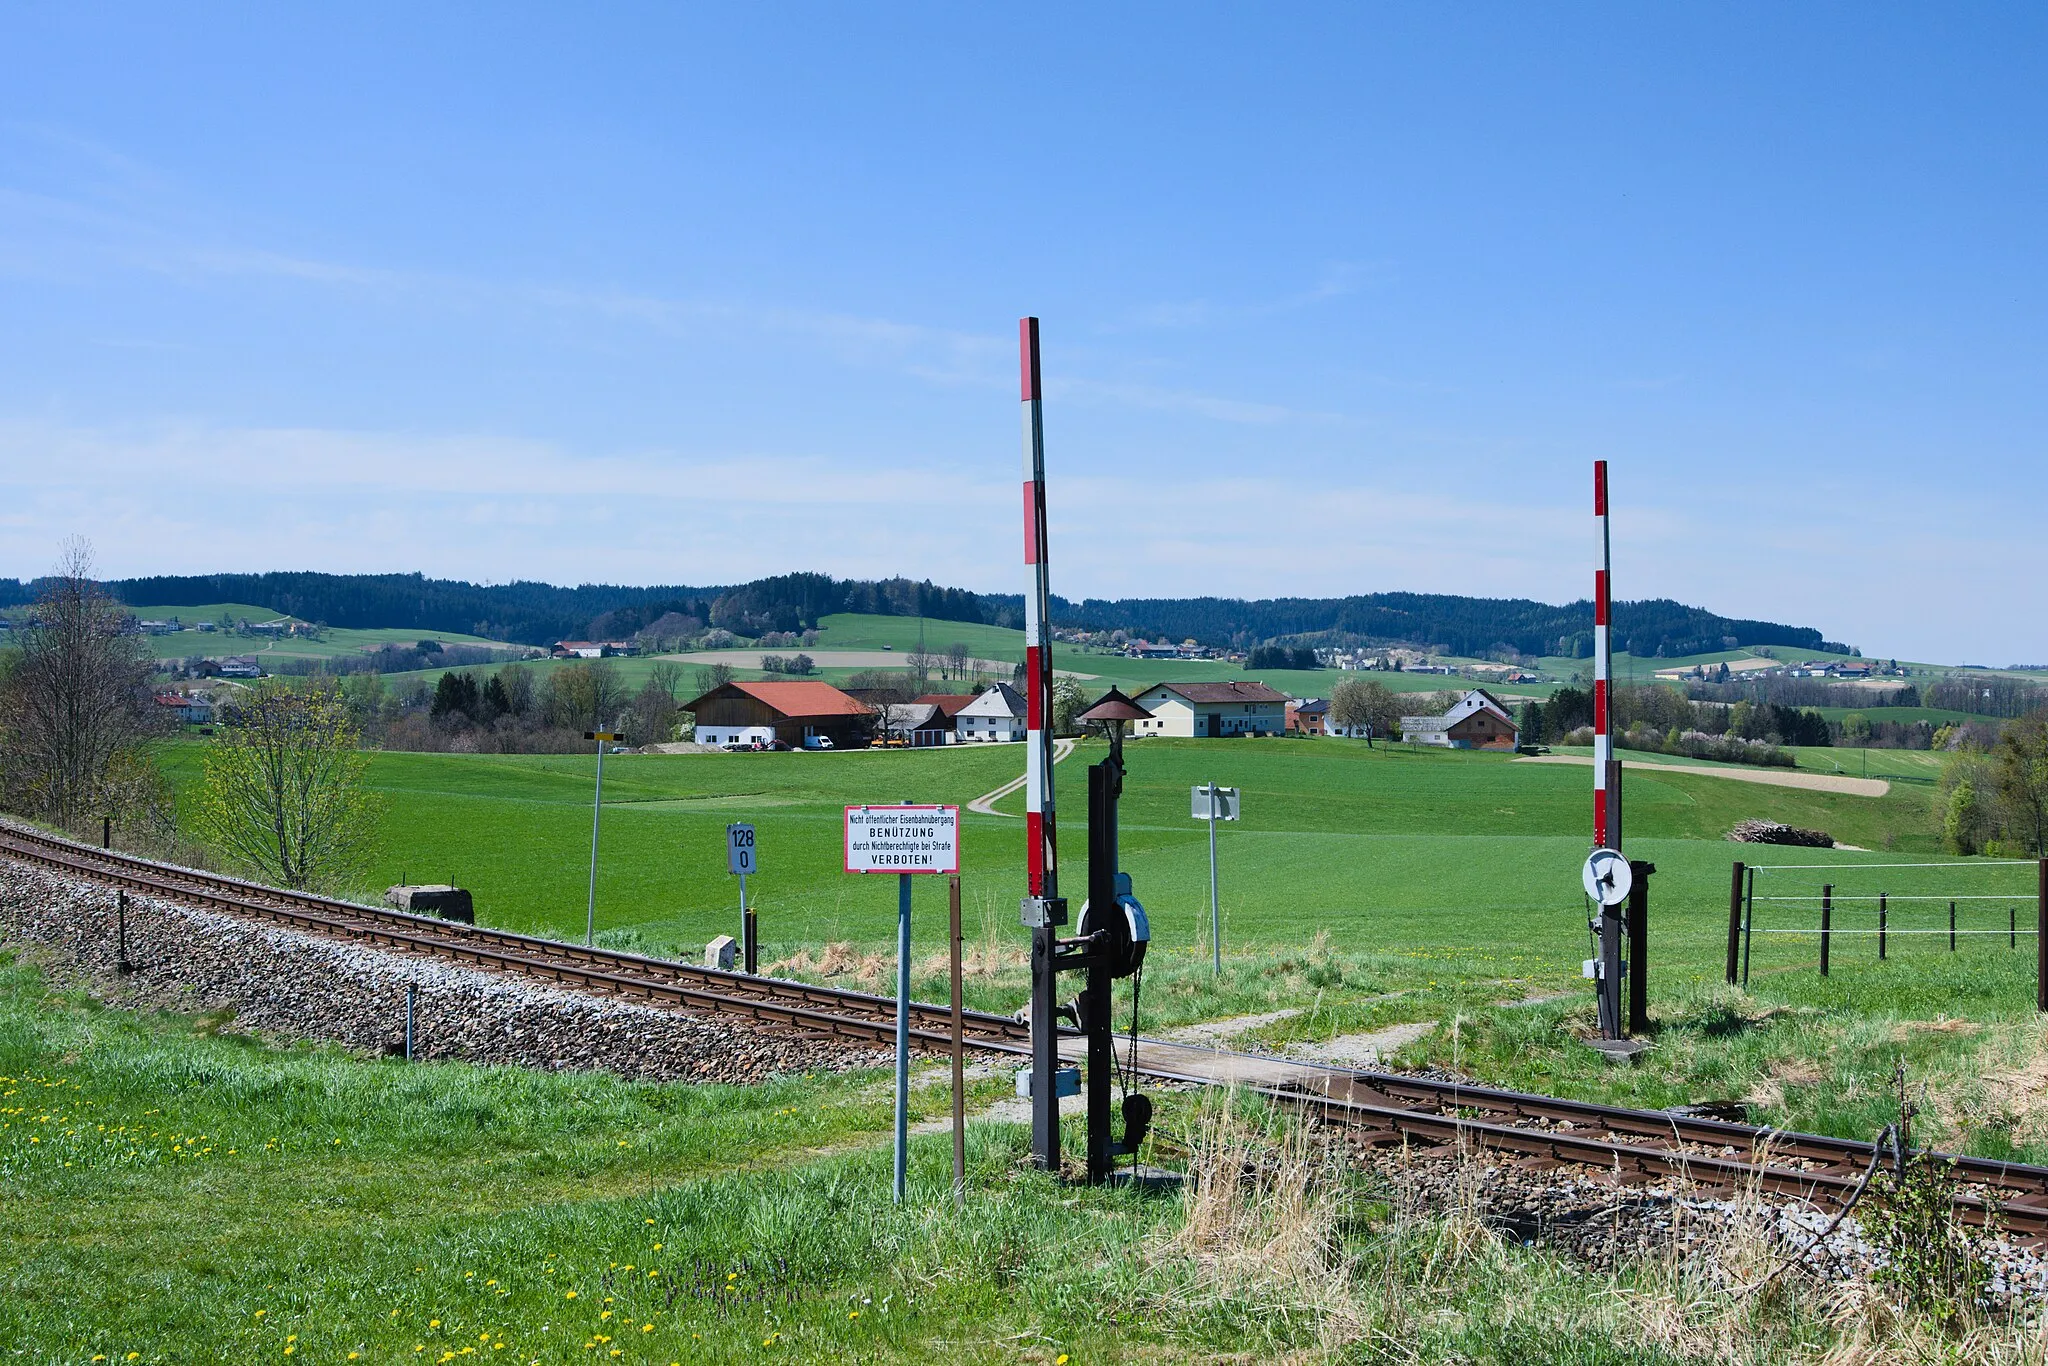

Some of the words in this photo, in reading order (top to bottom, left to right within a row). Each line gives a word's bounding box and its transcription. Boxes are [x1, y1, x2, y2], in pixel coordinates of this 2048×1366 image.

[850, 815, 864, 824] Nicht
[866, 815, 898, 824] öffentlicher
[900, 815, 954, 826] Eisenbahnübergang
[732, 829, 754, 847] 128
[870, 827, 934, 838] BENÜTZUNG
[853, 841, 870, 851] durch
[872, 841, 919, 853] Nichtberechtigte
[921, 841, 931, 851] bei
[932, 841, 951, 851] Strafe
[740, 850, 749, 868] 0
[872, 854, 933, 865] VERBOTEN!
